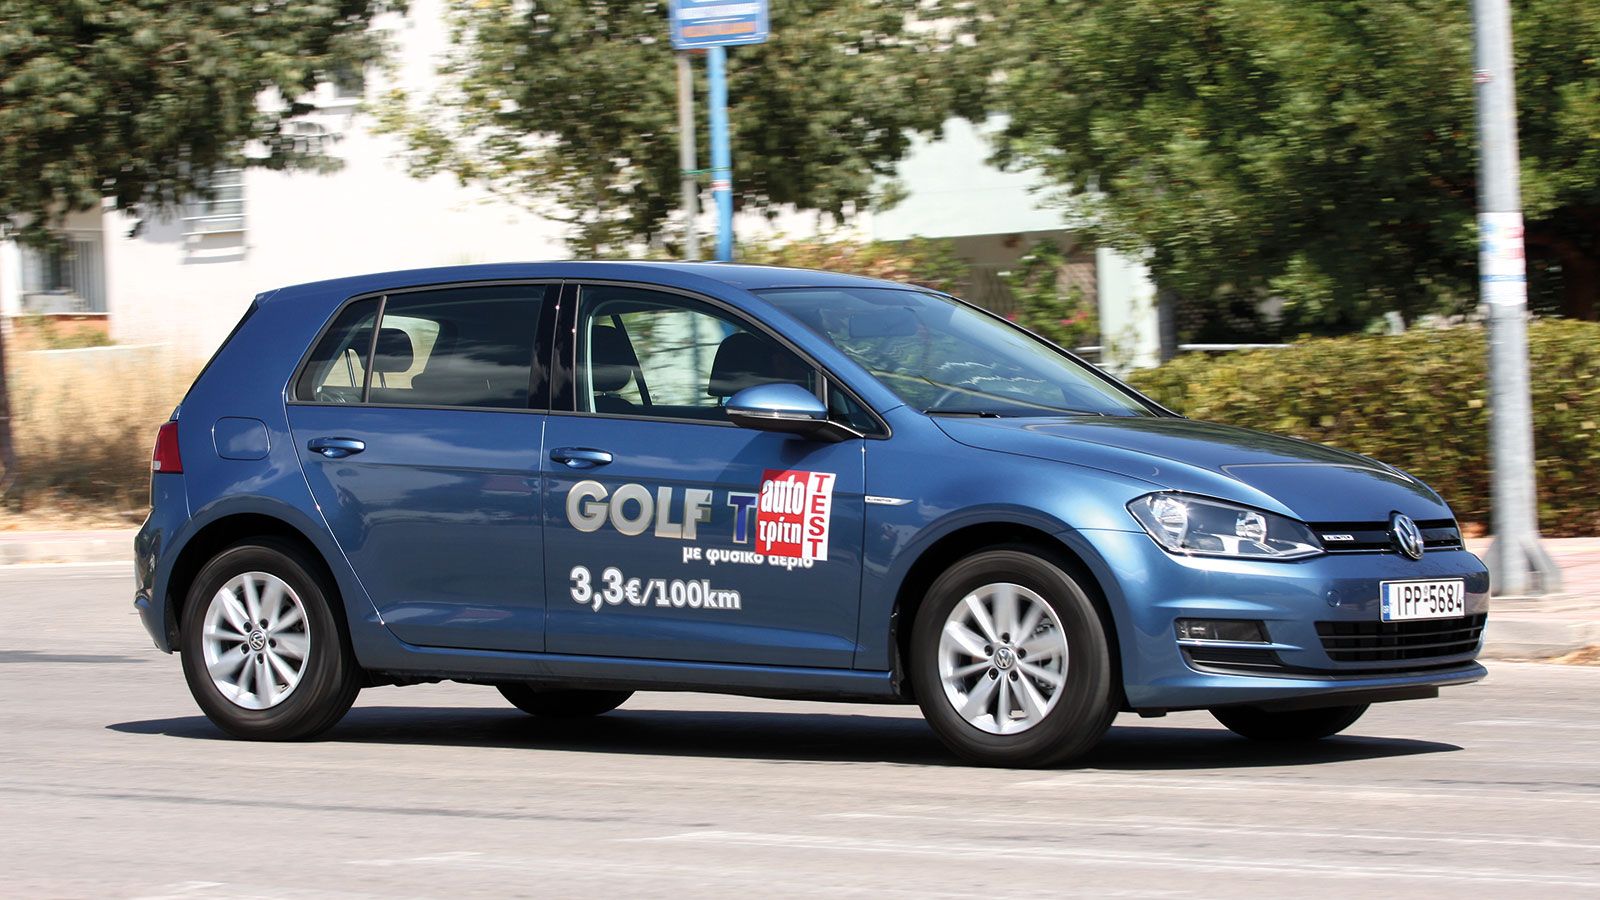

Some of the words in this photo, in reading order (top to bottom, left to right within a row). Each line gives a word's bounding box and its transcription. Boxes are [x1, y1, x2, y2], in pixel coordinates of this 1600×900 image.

[566, 480, 713, 540] GOLF
[760, 474, 806, 515] auto
[807, 474, 831, 558] TEST
[682, 546, 702, 563] με
[569, 565, 742, 612] 3,3€/100km
